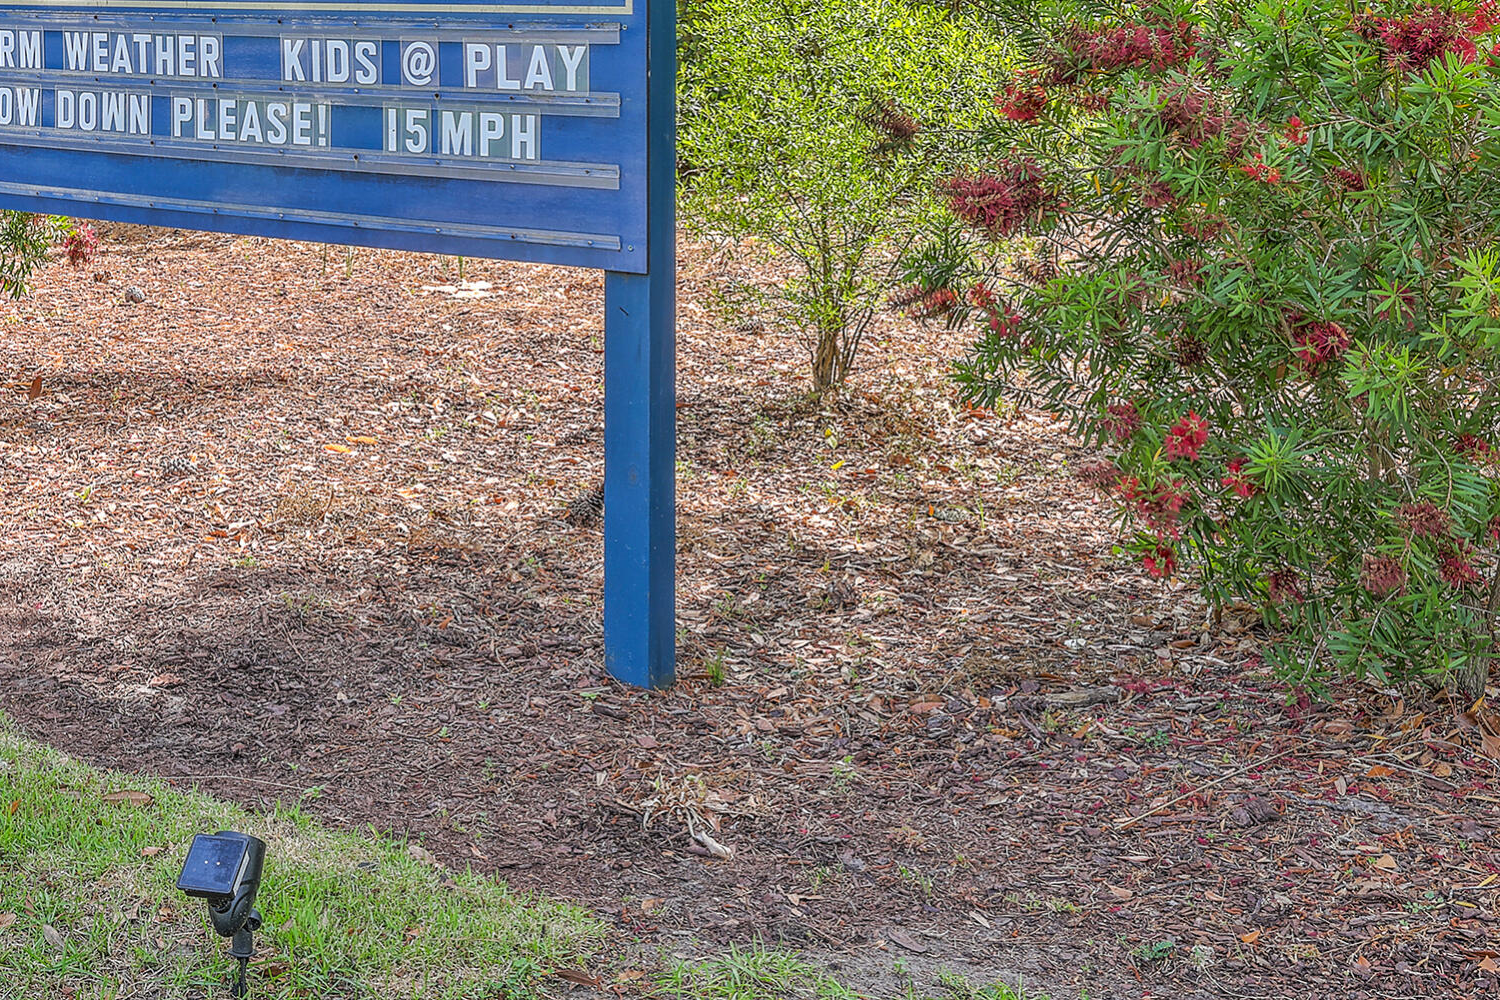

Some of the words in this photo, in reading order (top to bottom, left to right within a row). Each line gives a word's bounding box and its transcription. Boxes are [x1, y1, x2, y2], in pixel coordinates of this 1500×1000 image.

[64, 31, 220, 78] WEATHER
[284, 39, 378, 85] KIDS
[402, 41, 436, 84] @
[467, 43, 587, 93] PLAY
[56, 90, 149, 136] DOWN
[173, 94, 327, 147] PLEASE!
[387, 107, 428, 155] 15
[441, 110, 537, 161] MPH
